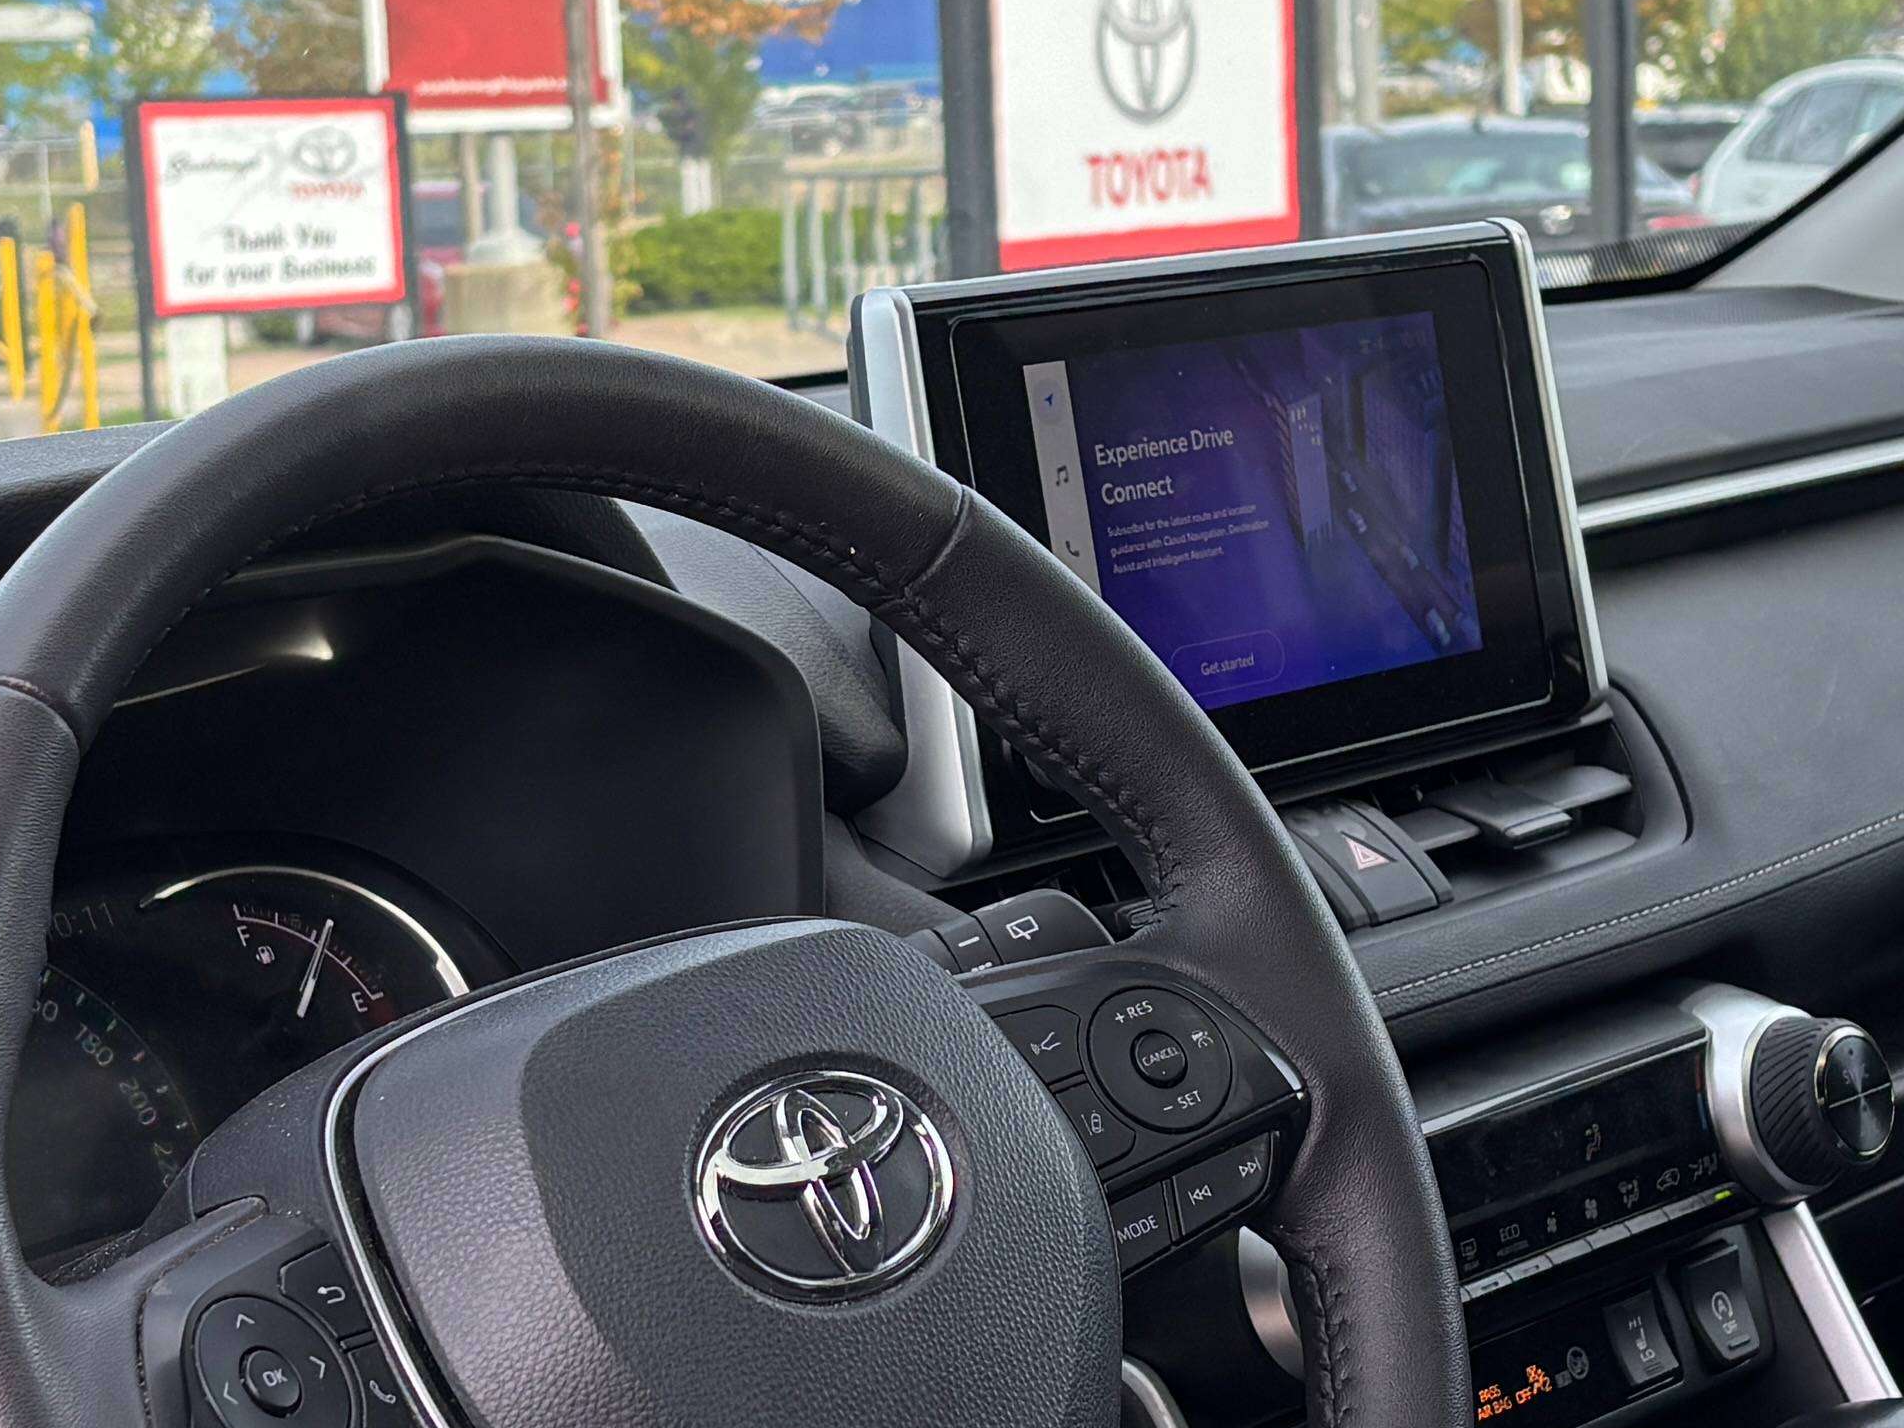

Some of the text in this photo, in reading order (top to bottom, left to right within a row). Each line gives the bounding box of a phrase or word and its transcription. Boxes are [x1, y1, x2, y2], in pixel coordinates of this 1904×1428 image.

[1085, 147, 1212, 208] TOYOTA
[223, 222, 337, 252] Thank You
[183, 255, 377, 287] for your Business
[1094, 426, 1235, 470] Experience Drive
[1101, 475, 1174, 507] Connect
[1157, 518, 1169, 529] the
[1164, 533, 1186, 546] Cloud
[1201, 652, 1255, 677] Get started
[237, 925, 250, 947] F
[352, 991, 368, 1013] E
[1116, 1214, 1160, 1245] MODE
[1499, 1223, 1521, 1243] ECO
[261, 1368, 289, 1388] OK
